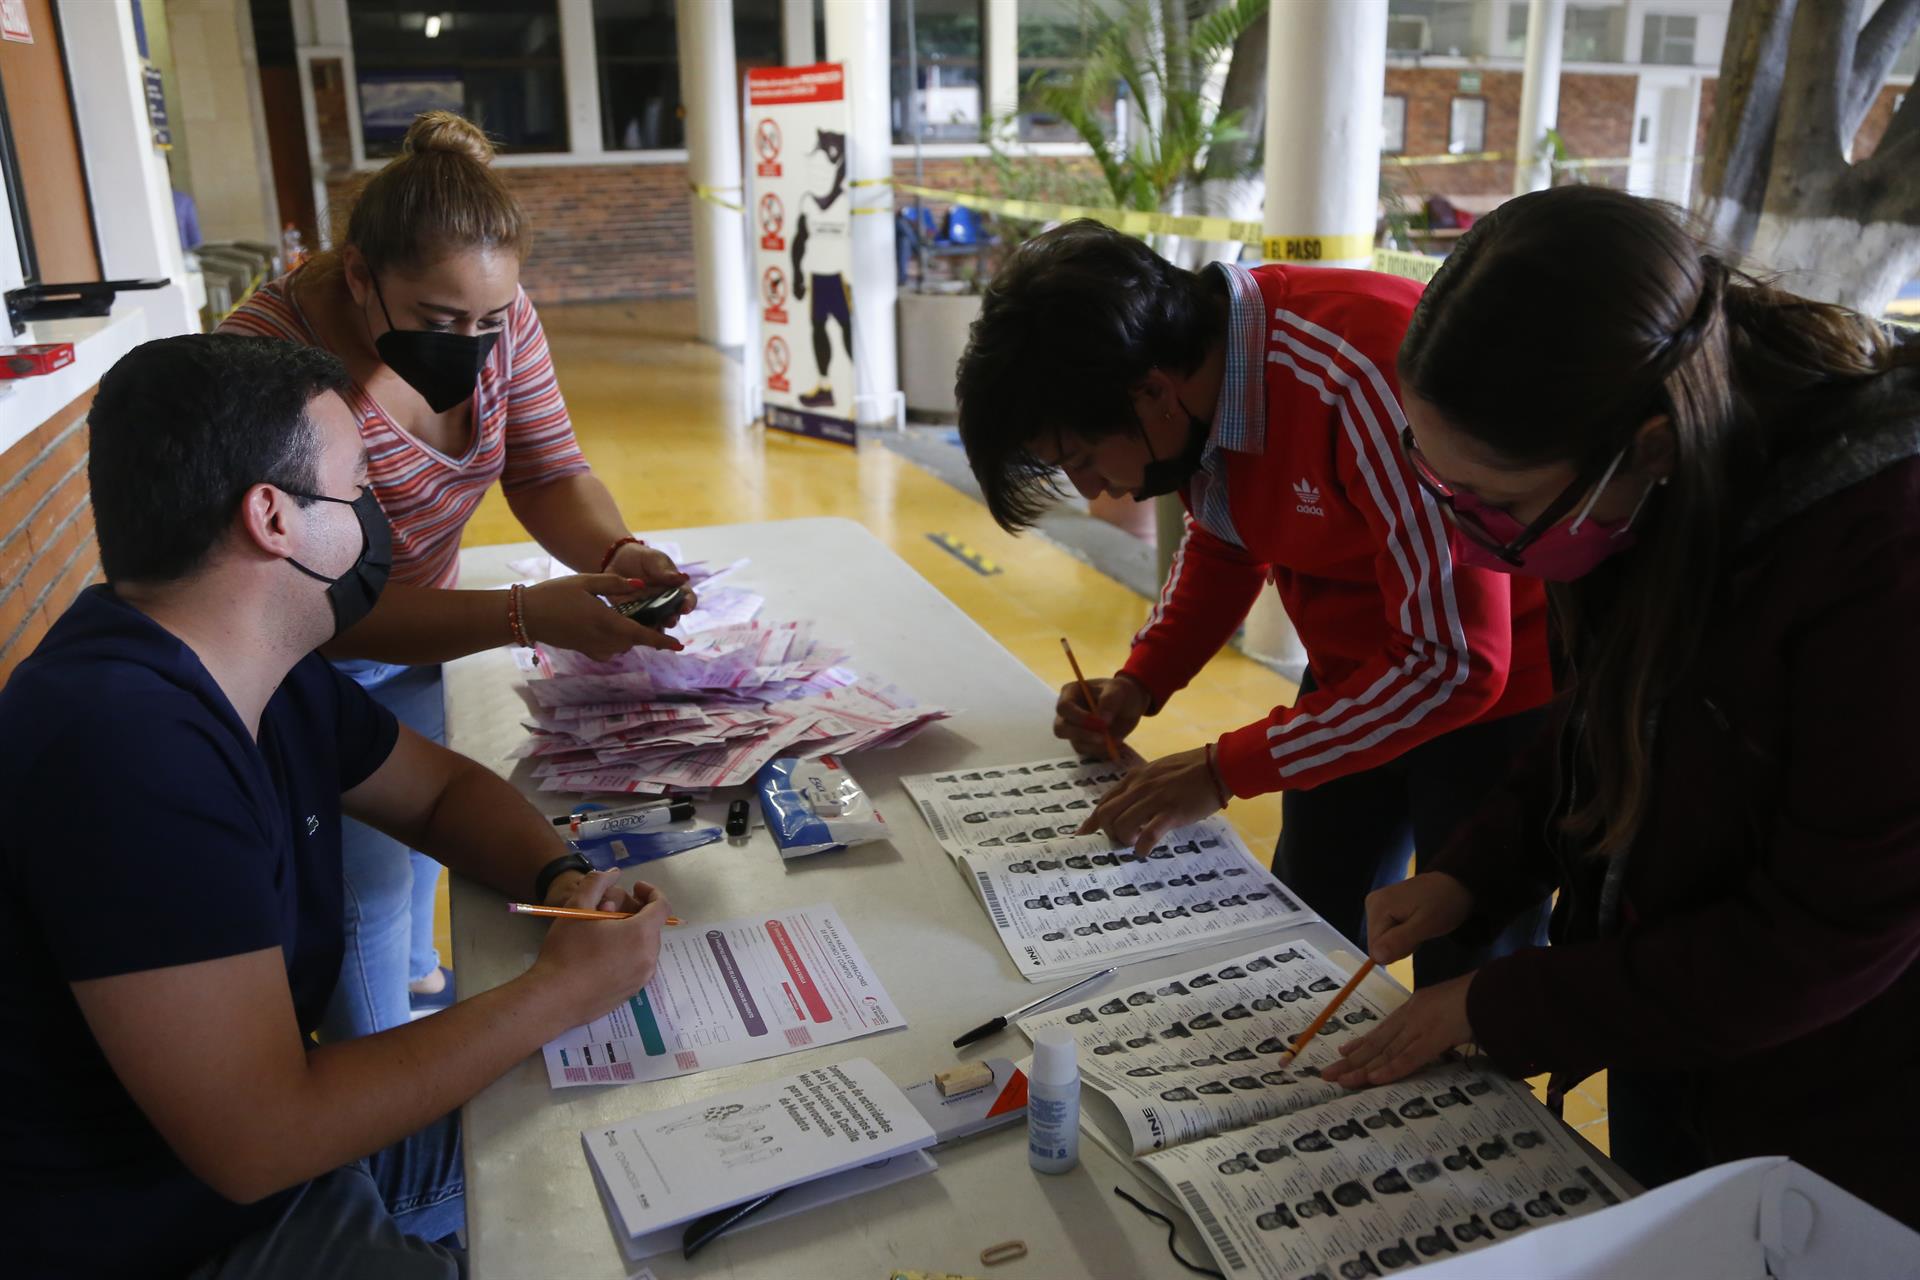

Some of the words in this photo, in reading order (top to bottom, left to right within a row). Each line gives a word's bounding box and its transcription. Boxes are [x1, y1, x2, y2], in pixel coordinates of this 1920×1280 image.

[1271, 240, 1283, 258] EL
[1286, 240, 1322, 260] PASO
[1024, 945, 1038, 960] INE
[847, 958, 869, 988] OPERACIONES
[778, 1097, 791, 1106] de
[784, 1084, 803, 1098] para
[798, 1095, 810, 1105] la
[827, 1065, 857, 1090] Compendio
[851, 1089, 864, 1098] de
[858, 1096, 893, 1134] actividades
[784, 1103, 811, 1132] Mandato
[796, 1073, 815, 1088] Mesa
[808, 1085, 836, 1113] Directiva
[829, 1110, 843, 1121] de
[836, 1118, 860, 1143] Casilla
[802, 1101, 836, 1138] Revocación
[834, 1090, 871, 1131] Funcionarios
[865, 1130, 879, 1141] de
[1141, 1107, 1161, 1137] INE
